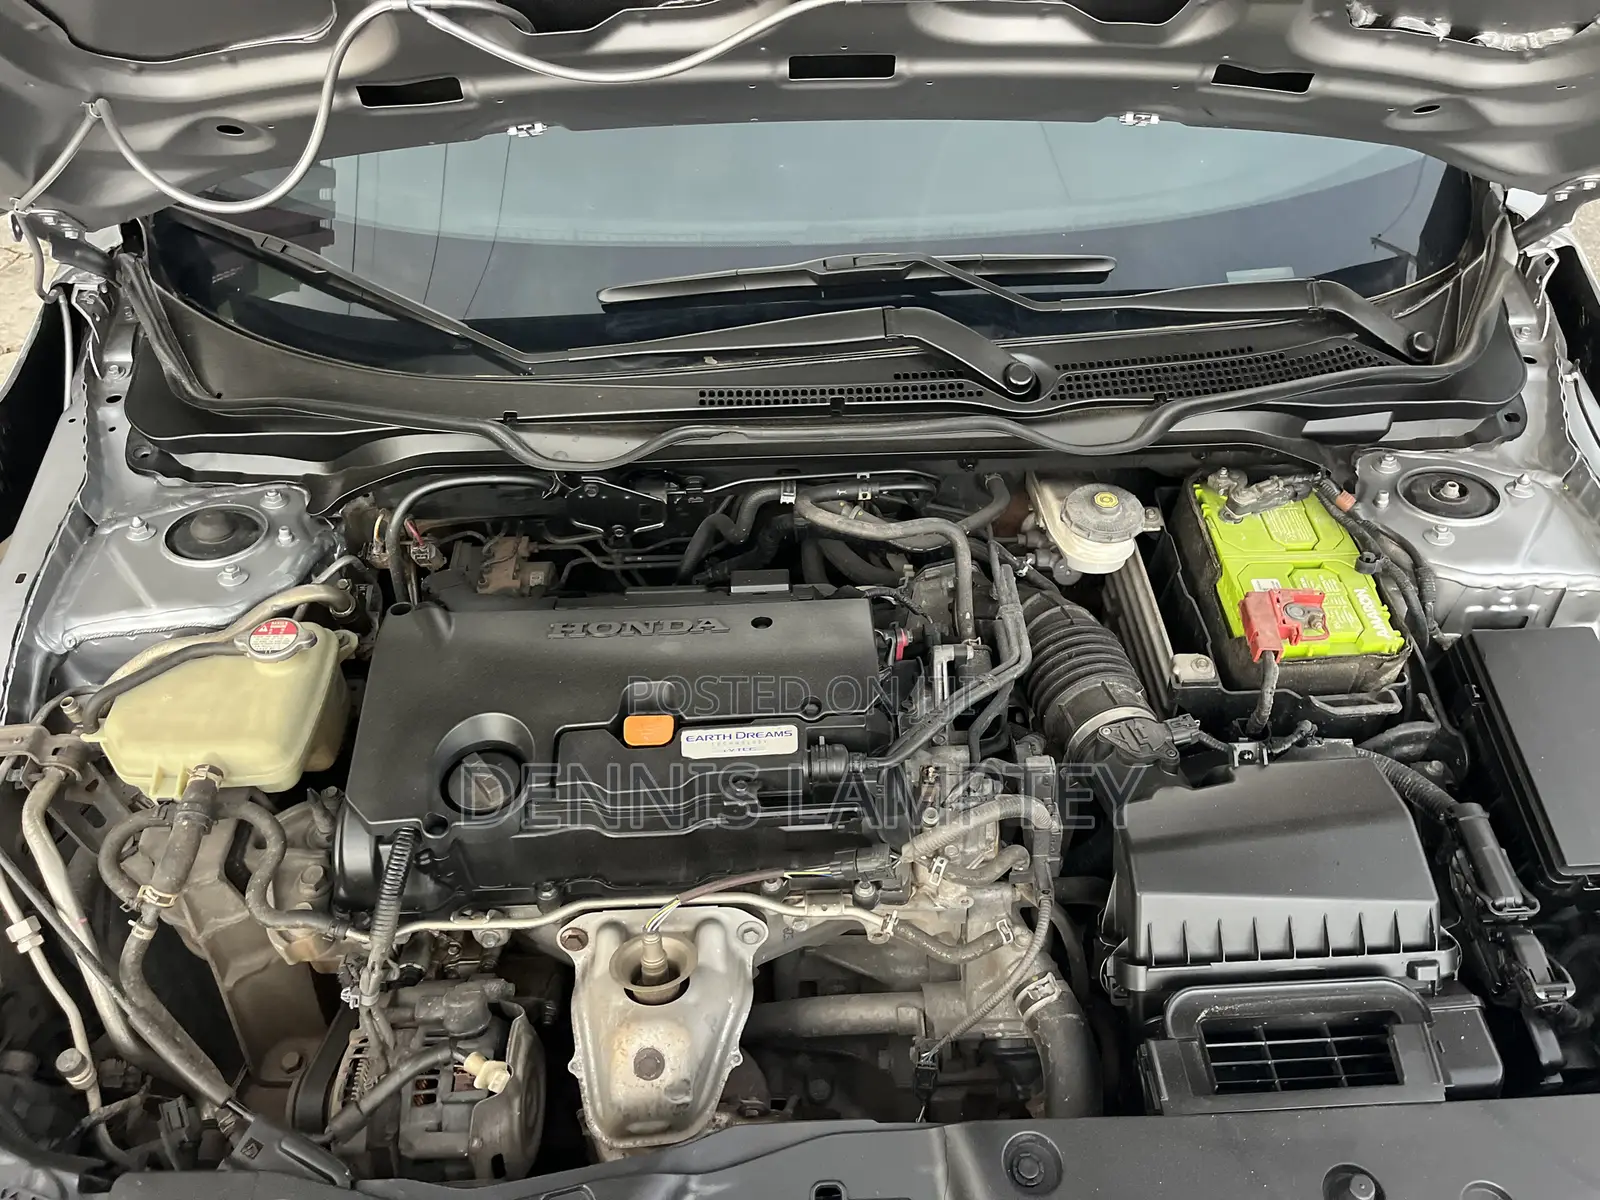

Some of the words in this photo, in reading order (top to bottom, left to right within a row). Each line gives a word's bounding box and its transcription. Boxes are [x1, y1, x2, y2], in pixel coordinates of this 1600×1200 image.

[1354, 587, 1393, 640] AMARON
[548, 617, 731, 640] HONDA
[685, 733, 733, 743] EARTH
[735, 730, 793, 740] DREAMS
